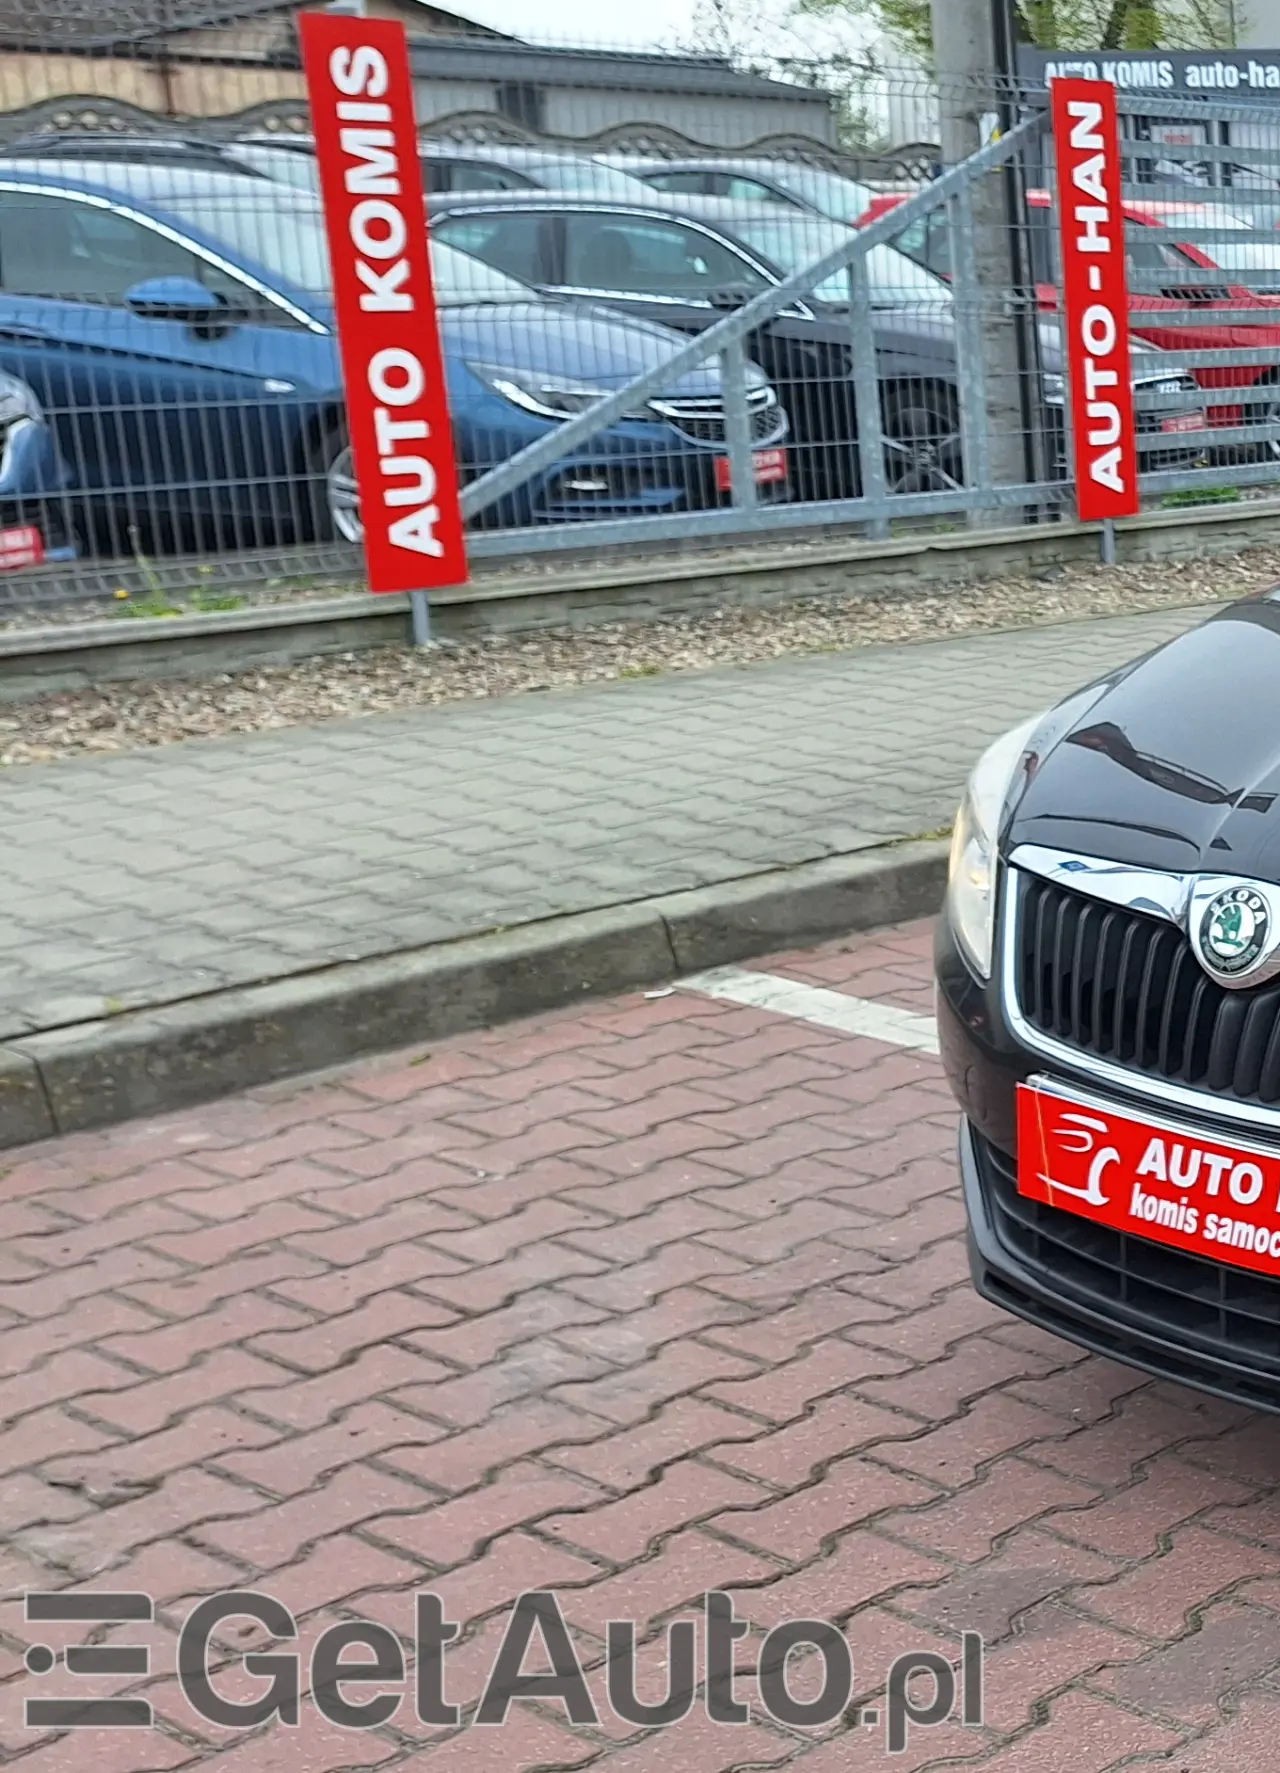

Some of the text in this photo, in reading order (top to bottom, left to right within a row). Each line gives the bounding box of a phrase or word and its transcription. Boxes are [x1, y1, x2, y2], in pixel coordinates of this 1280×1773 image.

[1102, 60, 1174, 88] KOMIS
[329, 45, 444, 558] AUTO KOMIS
[1136, 1137, 1263, 1205] AUTO
[1129, 1183, 1199, 1235] komis
